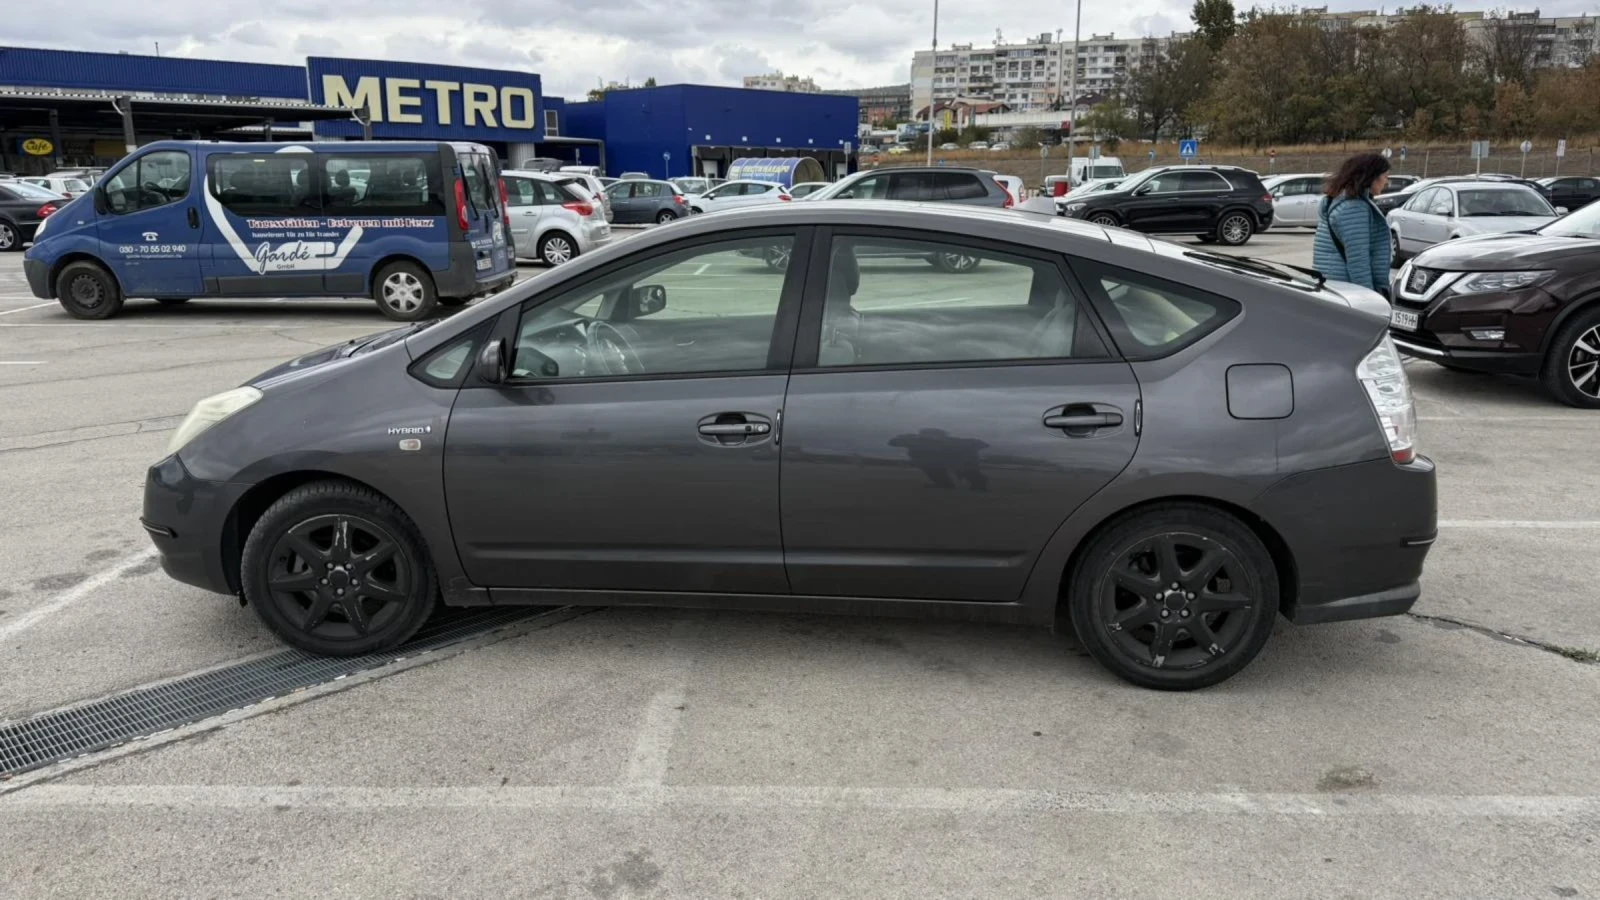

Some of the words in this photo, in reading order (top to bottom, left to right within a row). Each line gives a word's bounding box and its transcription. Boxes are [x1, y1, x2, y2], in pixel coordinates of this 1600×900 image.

[322, 74, 535, 129] METRO
[119, 245, 134, 253] 030
[172, 244, 187, 252] 940
